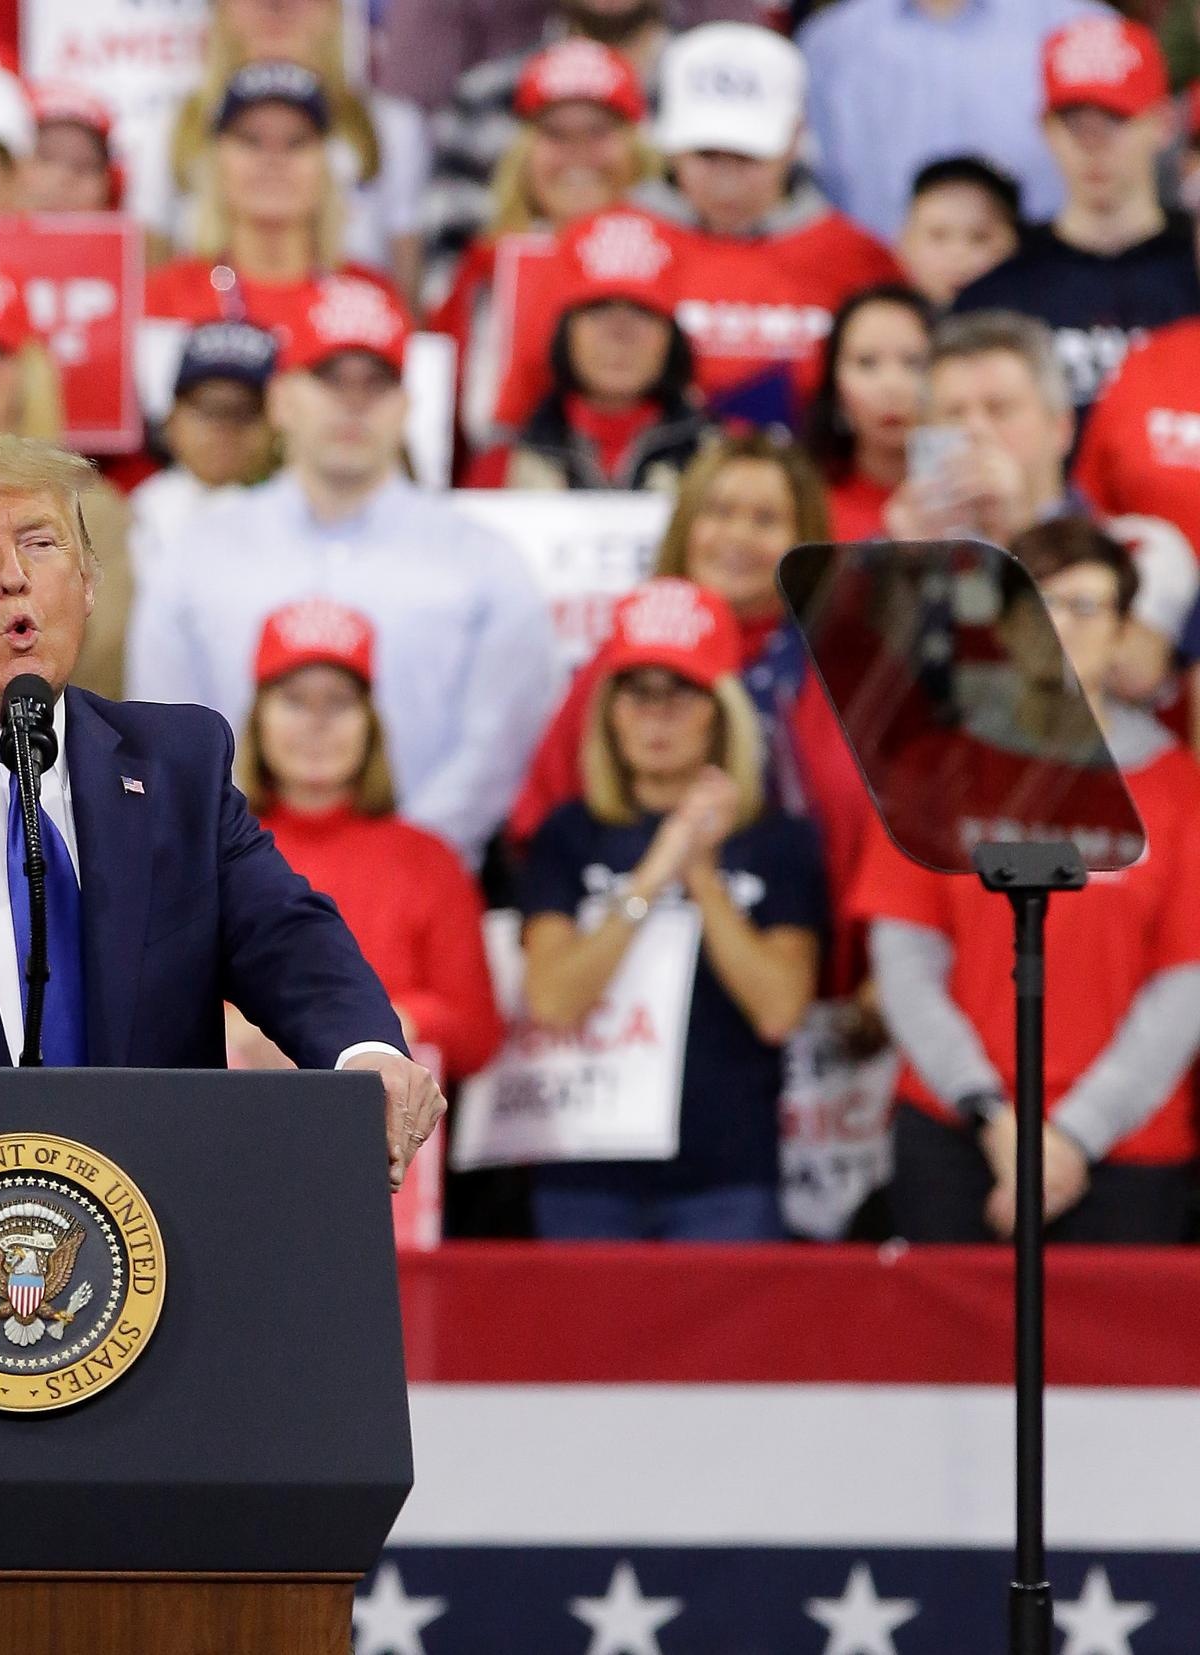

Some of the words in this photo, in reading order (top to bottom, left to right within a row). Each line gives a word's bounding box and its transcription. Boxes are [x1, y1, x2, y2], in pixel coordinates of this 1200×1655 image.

[674, 299, 834, 345] RUMP
[35, 1147, 61, 1165] OF
[66, 1154, 100, 1183] THE
[104, 1181, 156, 1296] UNITED
[46, 1319, 141, 1400] STATES
